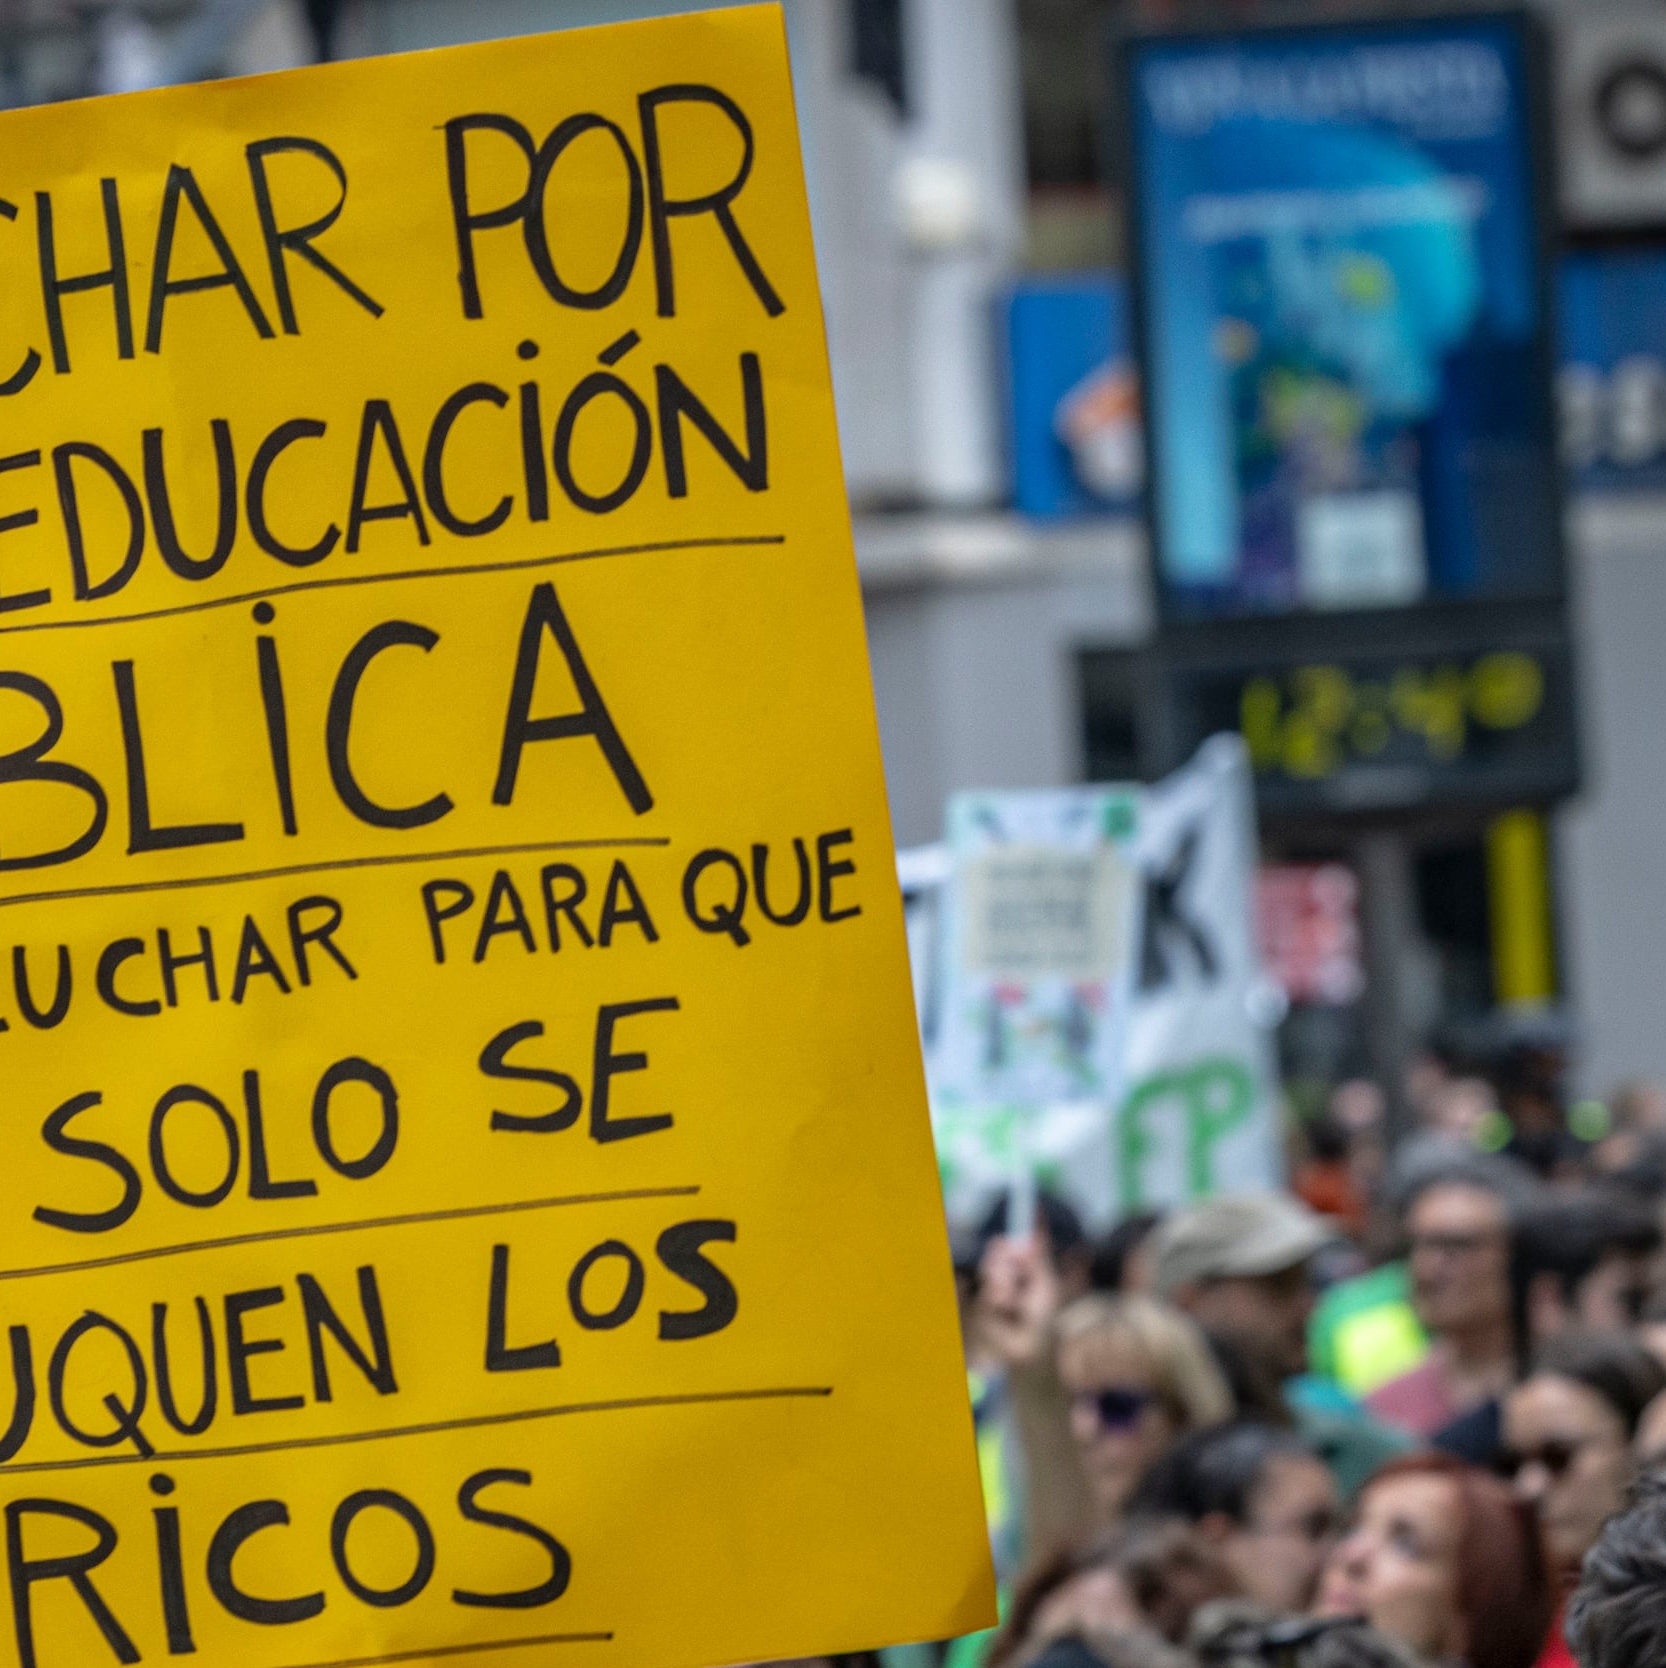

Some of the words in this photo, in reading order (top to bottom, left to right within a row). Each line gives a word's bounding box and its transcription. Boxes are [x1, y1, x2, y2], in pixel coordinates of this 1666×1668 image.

[441, 81, 788, 322] POR
[420, 858, 661, 966] PARA
[680, 826, 864, 949] QUE
[31, 1055, 400, 1235] SOLO
[477, 995, 682, 1146] SE
[483, 1217, 740, 1374] LOS
